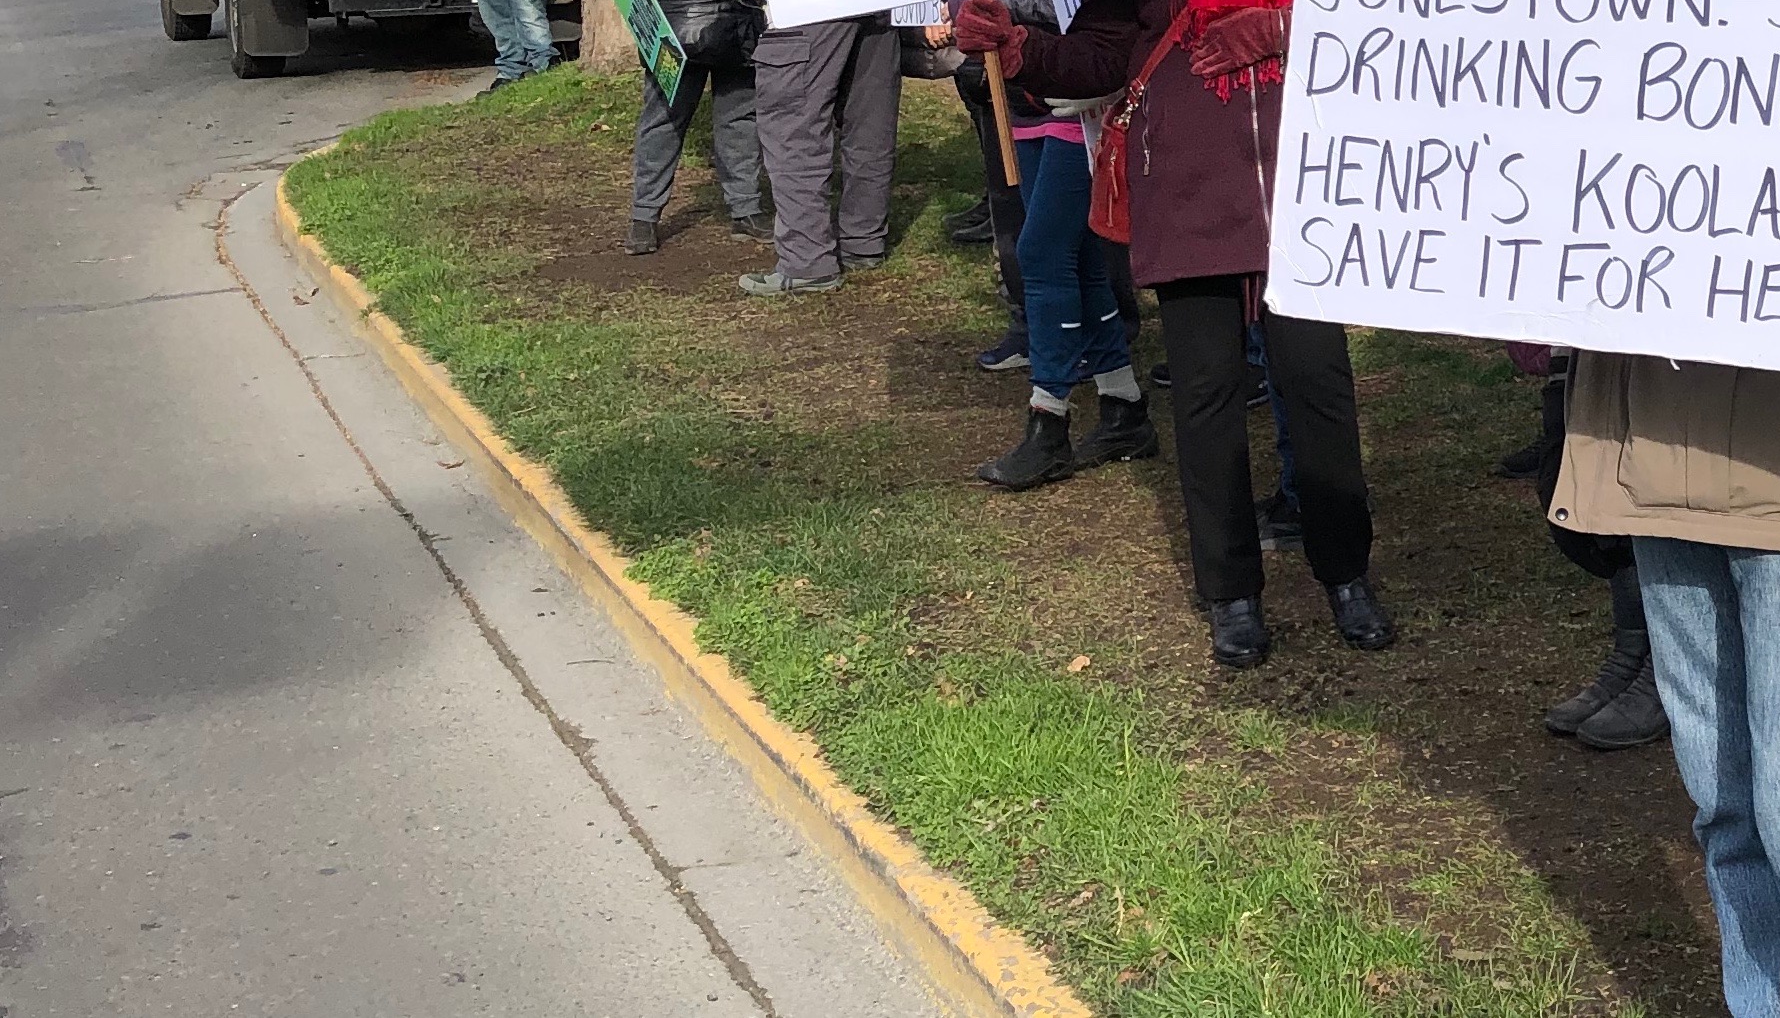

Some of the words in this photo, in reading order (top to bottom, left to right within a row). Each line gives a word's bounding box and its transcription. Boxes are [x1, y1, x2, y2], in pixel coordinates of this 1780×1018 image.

[1306, 27, 1603, 116] DRINKING
[1295, 132, 1530, 225] HENRY'S
[1294, 217, 1446, 294] SAVE
[1478, 238, 1543, 302] IT
[1557, 241, 1676, 314] FOR
